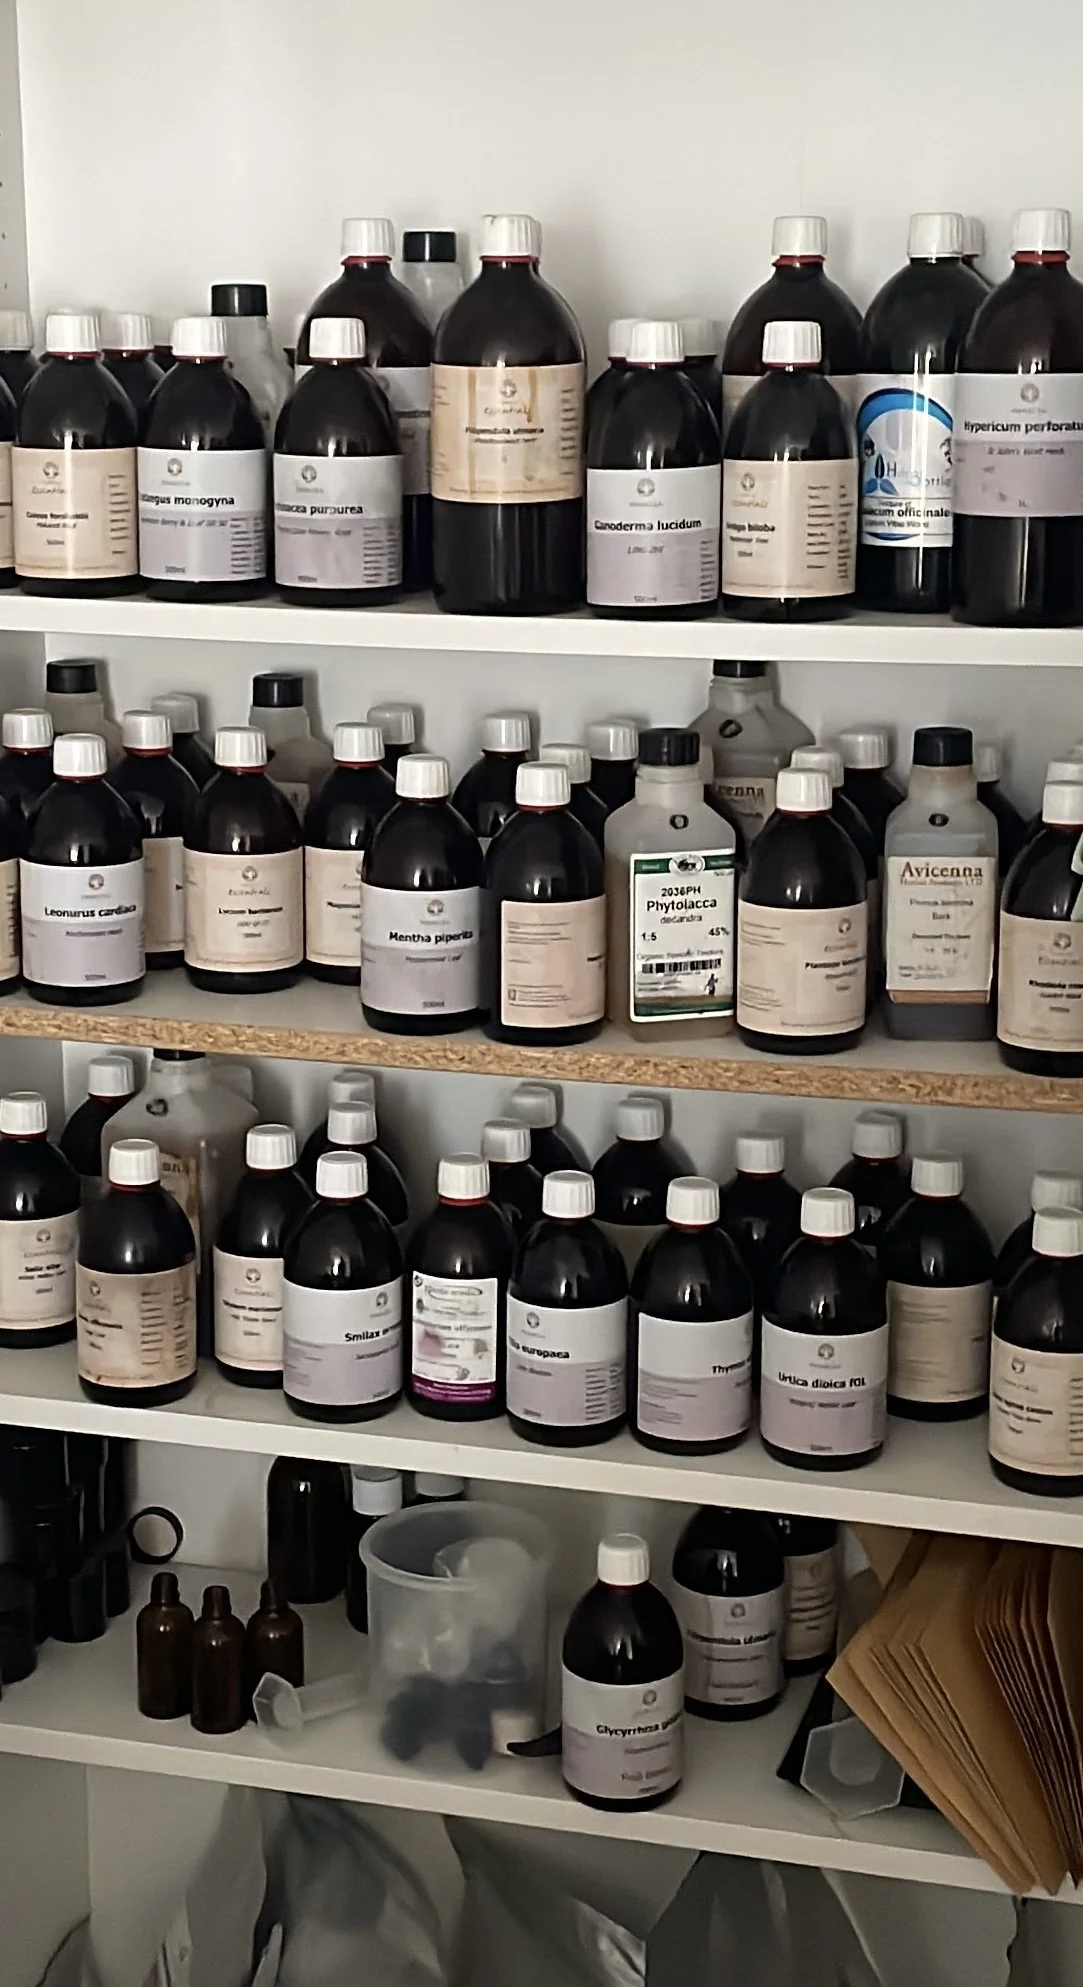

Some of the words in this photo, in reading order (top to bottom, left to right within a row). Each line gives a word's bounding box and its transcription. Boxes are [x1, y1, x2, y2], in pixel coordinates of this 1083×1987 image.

[174, 496, 235, 508] monogyna
[310, 505, 364, 516] purpurea
[657, 518, 702, 531] lucidum
[900, 861, 983, 878] Avicenna
[44, 906, 96, 918] Leonurus
[646, 898, 718, 914] Phytolacca
[389, 931, 432, 943] Mentha
[344, 1330, 380, 1342] Smilax
[778, 1371, 809, 1387] Urtica
[811, 1378, 847, 1389] dioica
